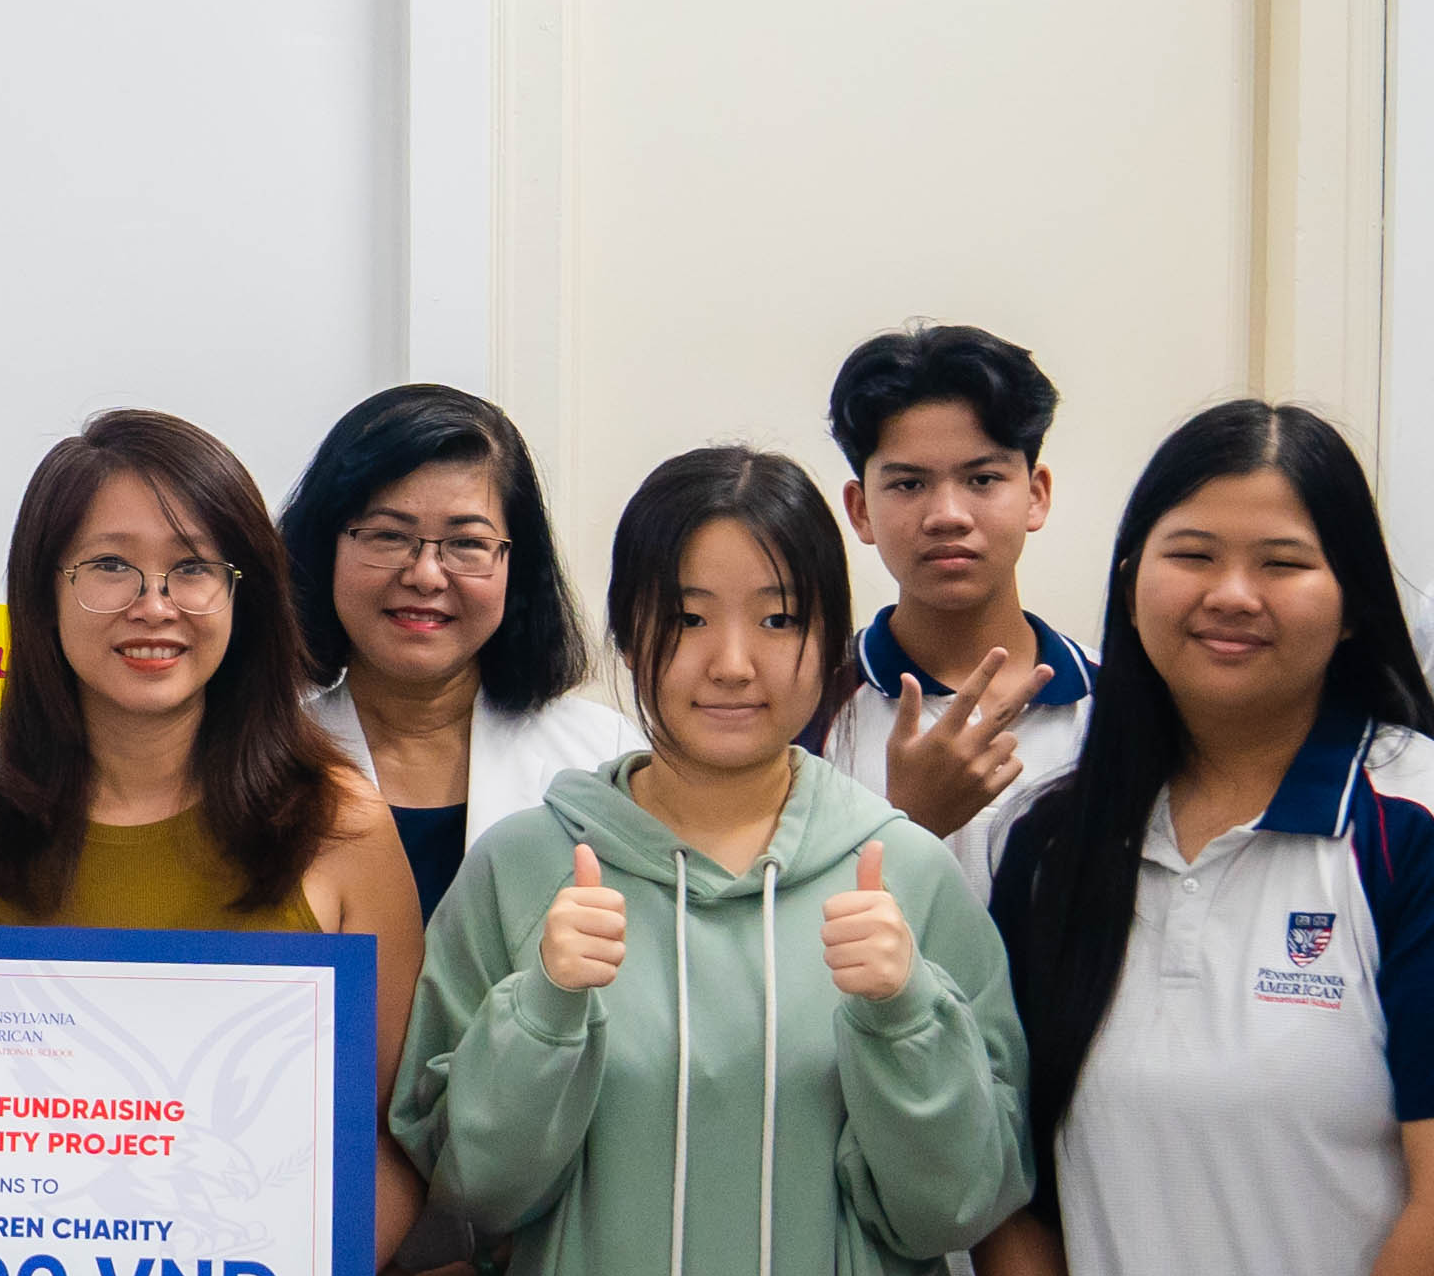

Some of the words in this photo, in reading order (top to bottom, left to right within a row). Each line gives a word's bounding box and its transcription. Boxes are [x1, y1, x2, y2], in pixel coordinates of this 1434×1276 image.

[1257, 967, 1346, 987] PENNSYLVANIA
[1254, 980, 1345, 1001] AMERICAN
[48, 1133, 175, 1157] PROJECT
[31, 1178, 59, 1195] TO
[52, 1217, 173, 1242] CHARITY
